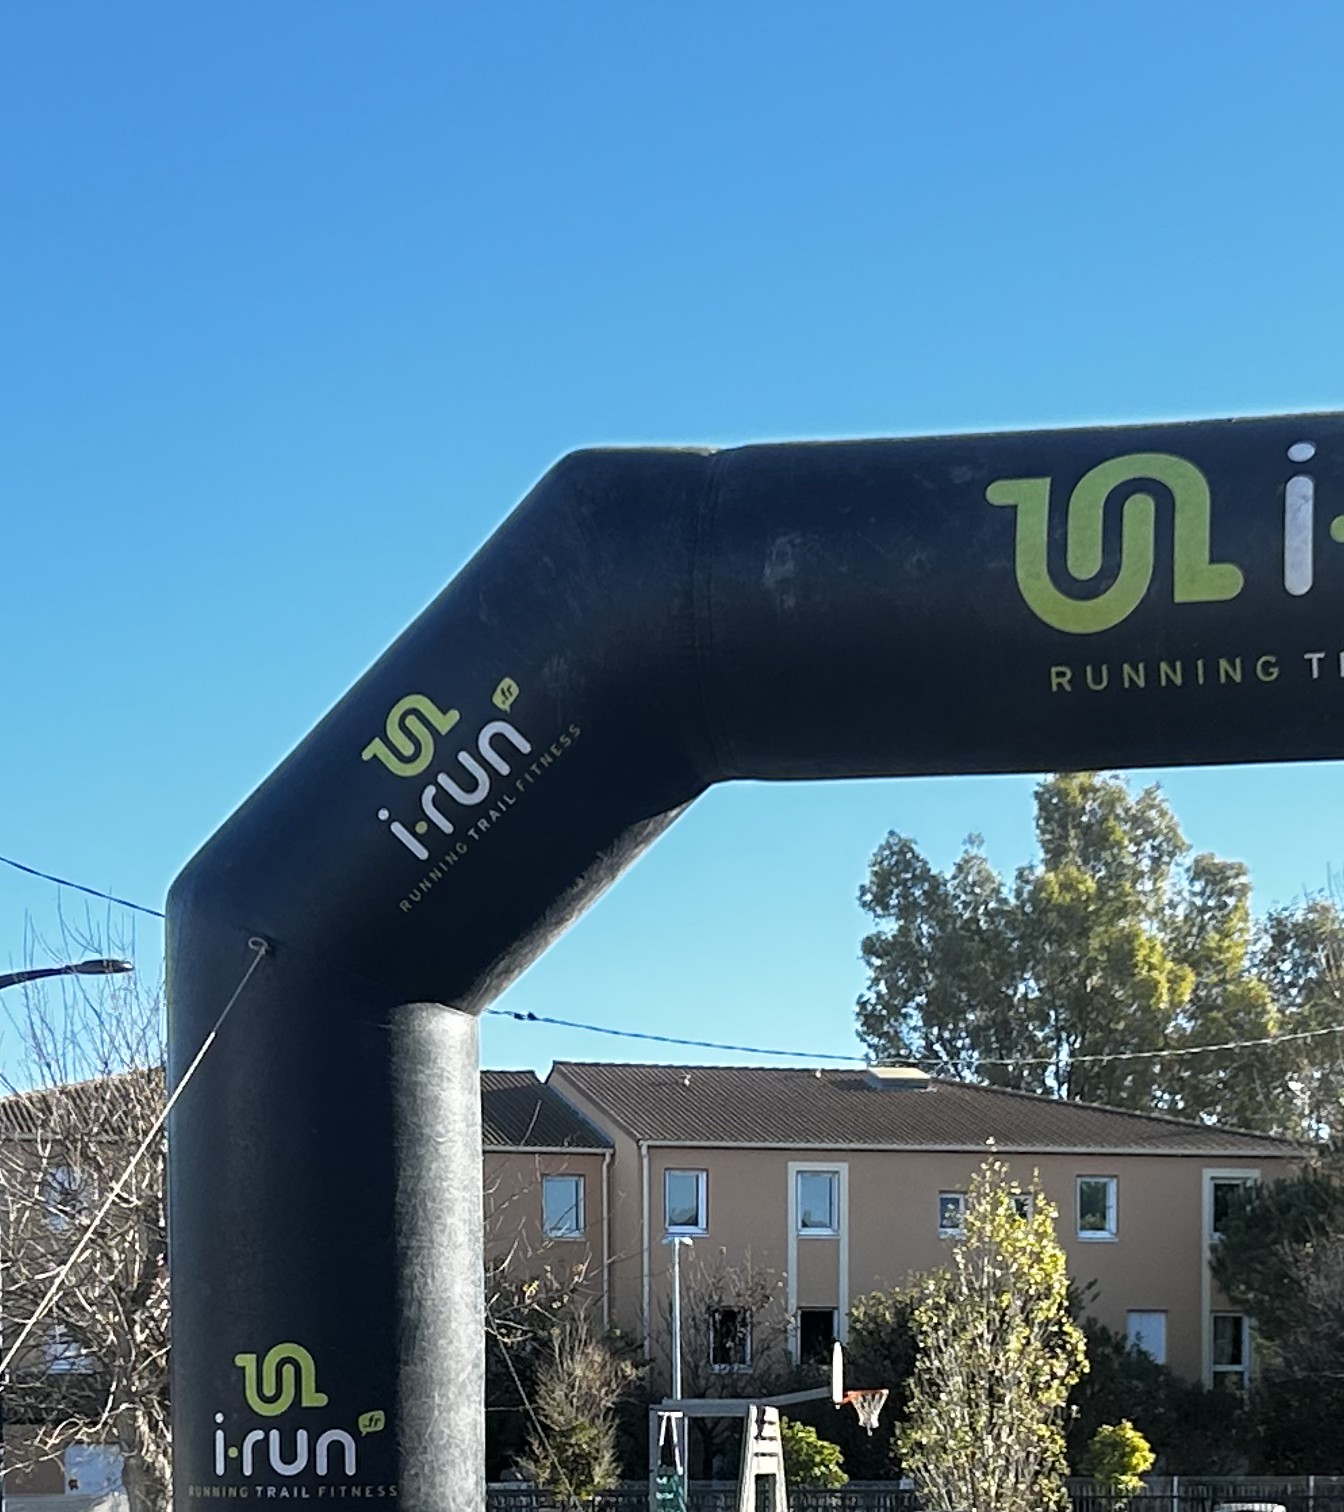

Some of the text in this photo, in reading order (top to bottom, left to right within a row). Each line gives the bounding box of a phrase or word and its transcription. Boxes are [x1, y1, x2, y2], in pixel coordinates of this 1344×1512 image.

[1050, 653, 1282, 693] RUNNING
[399, 723, 582, 913] RUNNING TRAIL FITNESS
[188, 1484, 399, 1498] RUNNING TRAIL FITNESS
